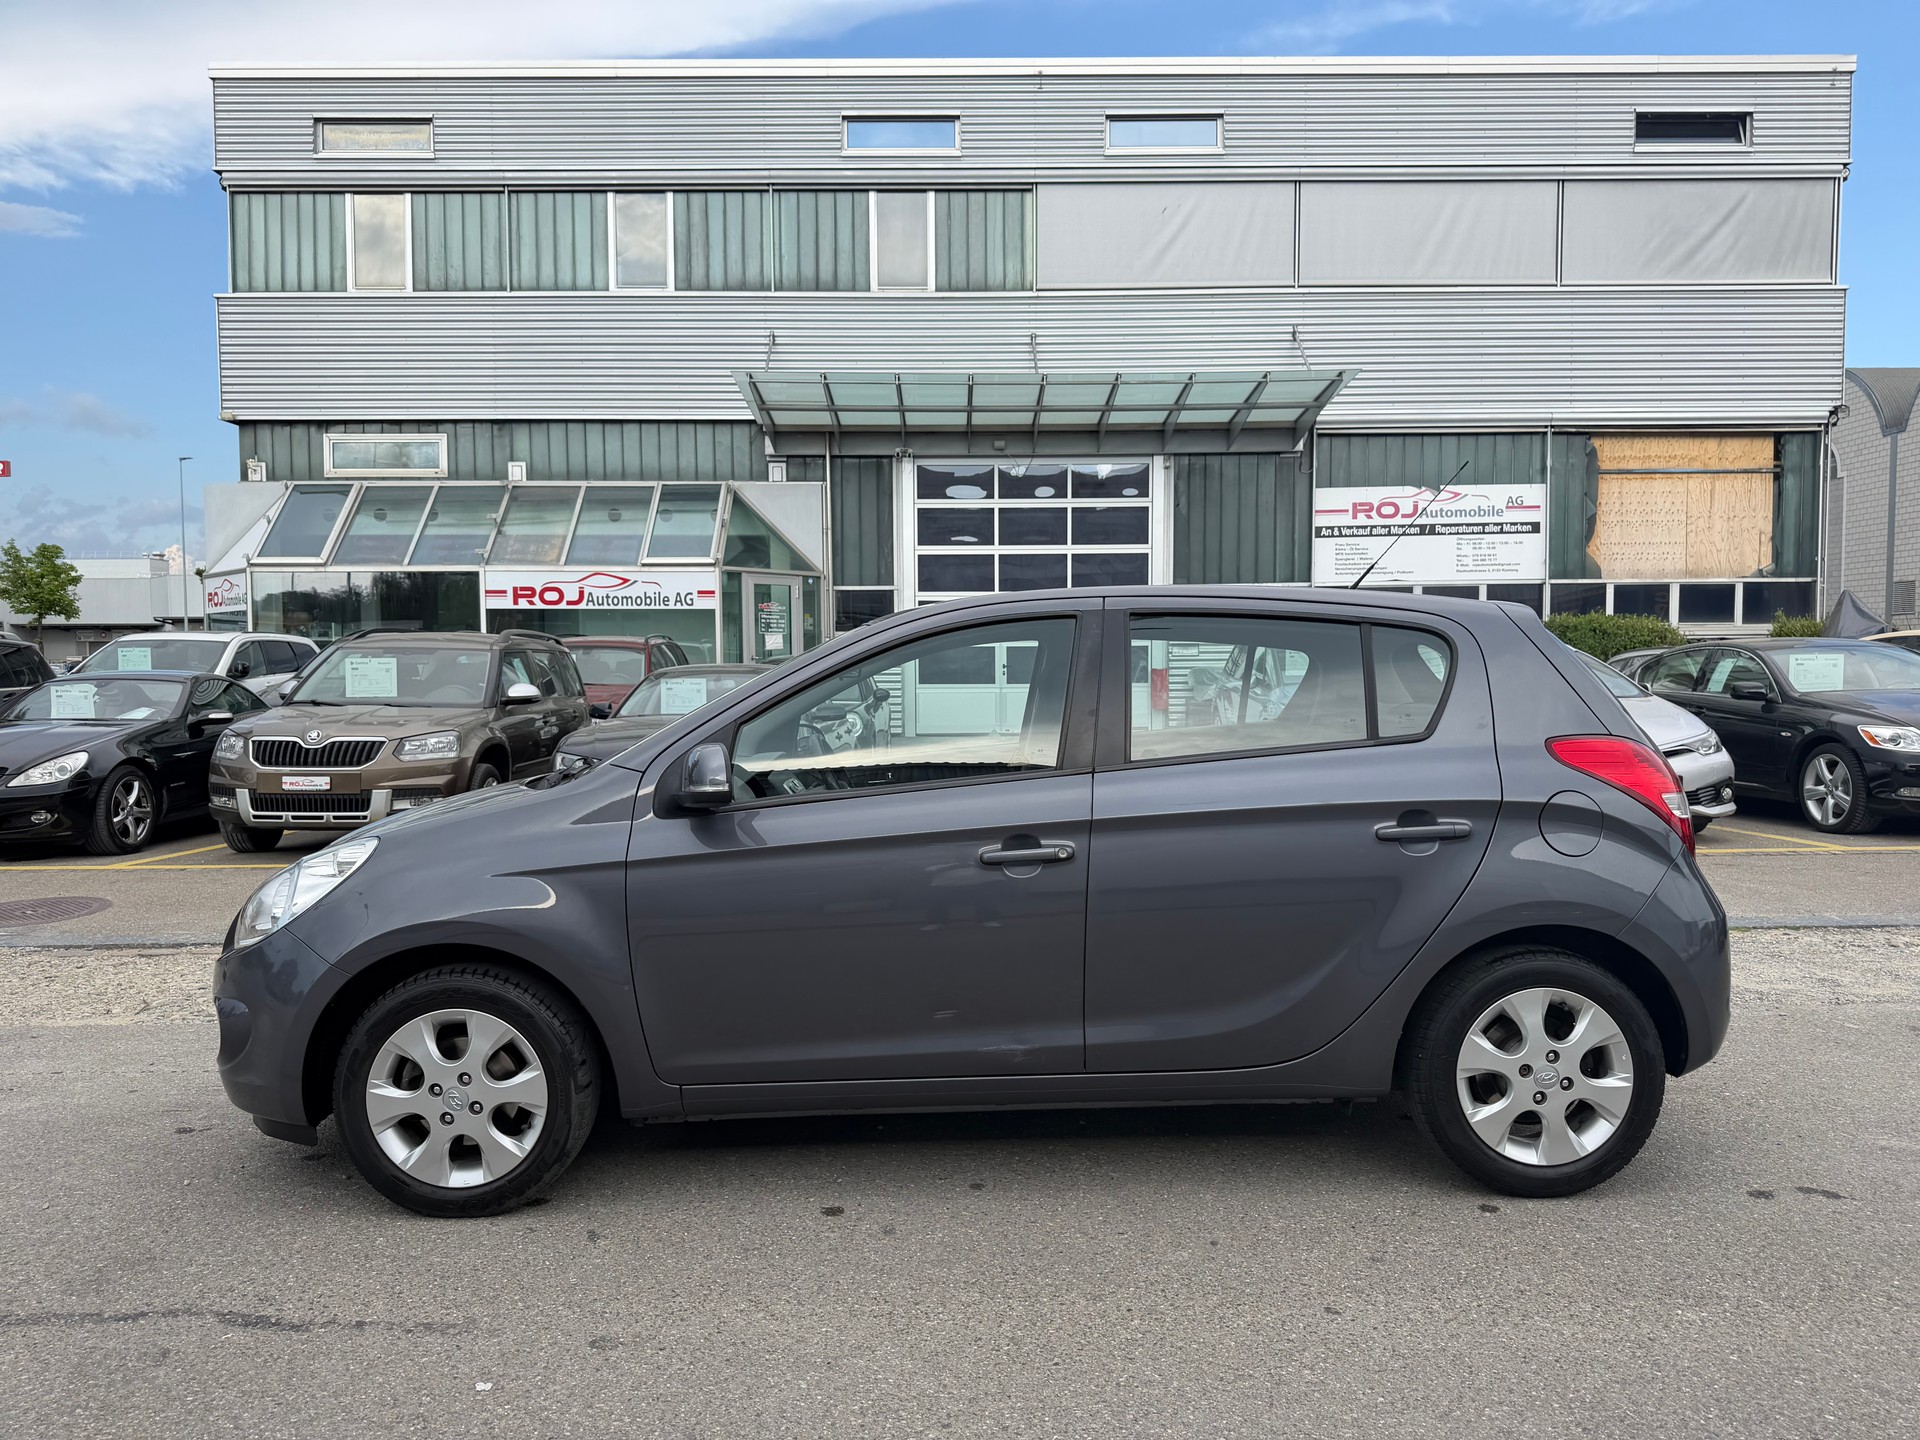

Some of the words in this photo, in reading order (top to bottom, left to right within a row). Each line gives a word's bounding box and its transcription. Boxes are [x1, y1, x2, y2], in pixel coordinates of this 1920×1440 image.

[1352, 501, 1419, 520] ROJ
[1419, 505, 1504, 519] Automobile
[1506, 496, 1524, 506] AG
[1320, 527, 1332, 537] An
[1333, 527, 1340, 536] &
[1340, 527, 1372, 536] Verkauf
[1372, 526, 1389, 535] aller
[1390, 525, 1420, 535] Marken
[1435, 524, 1483, 535] Reparaturen
[1484, 523, 1502, 533] aller
[1503, 523, 1533, 533] Marken
[208, 590, 223, 608] ROJ
[512, 586, 585, 606] ROJ
[586, 591, 670, 607] Automobile
[674, 592, 694, 607] AG
